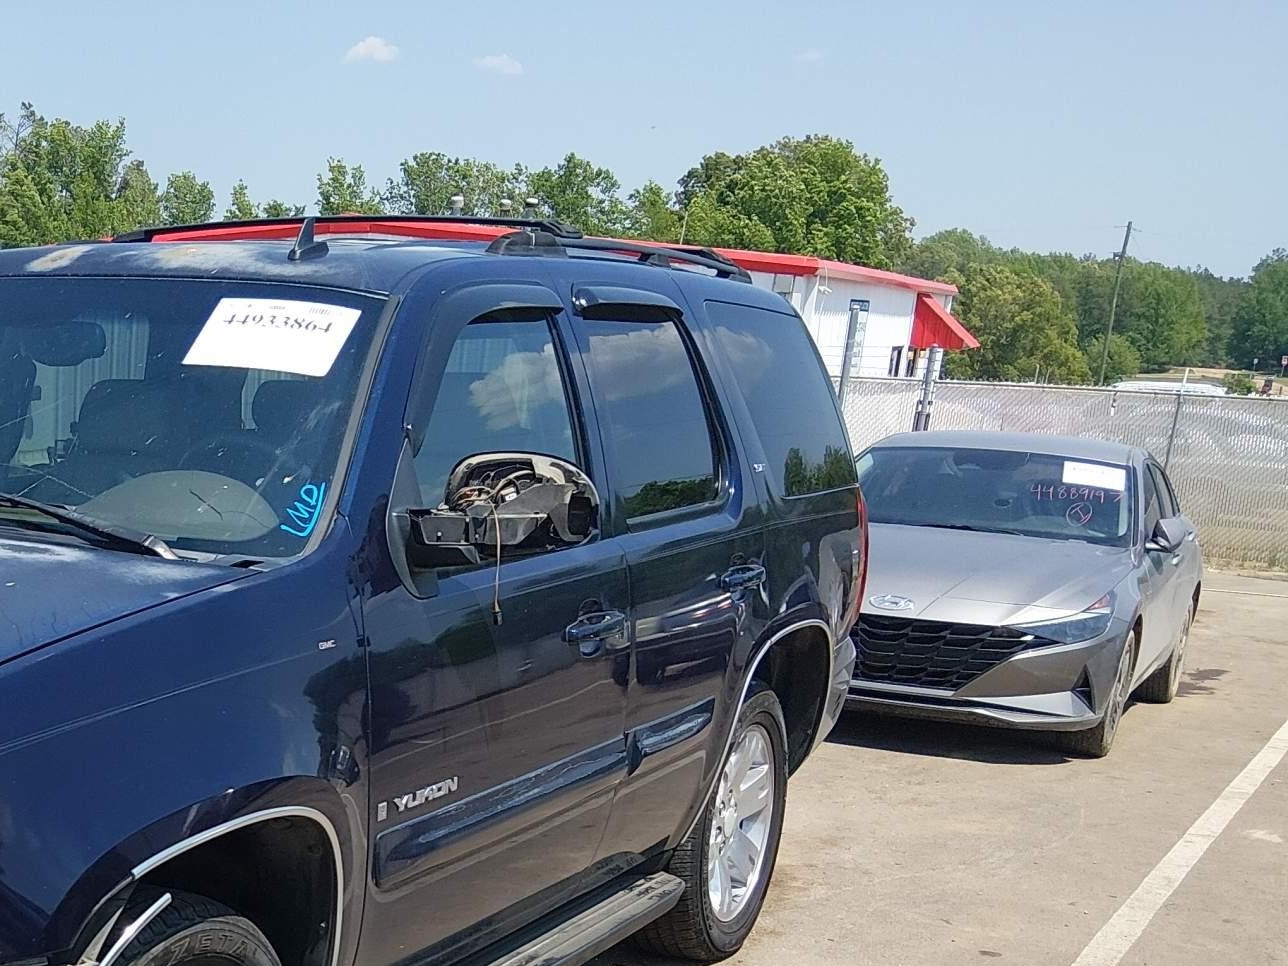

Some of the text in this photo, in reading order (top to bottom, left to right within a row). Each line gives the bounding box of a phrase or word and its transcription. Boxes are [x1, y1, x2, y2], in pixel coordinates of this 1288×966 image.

[223, 313, 333, 333] 44933864
[318, 639, 337, 650] GMC
[393, 775, 458, 812] YUKON
